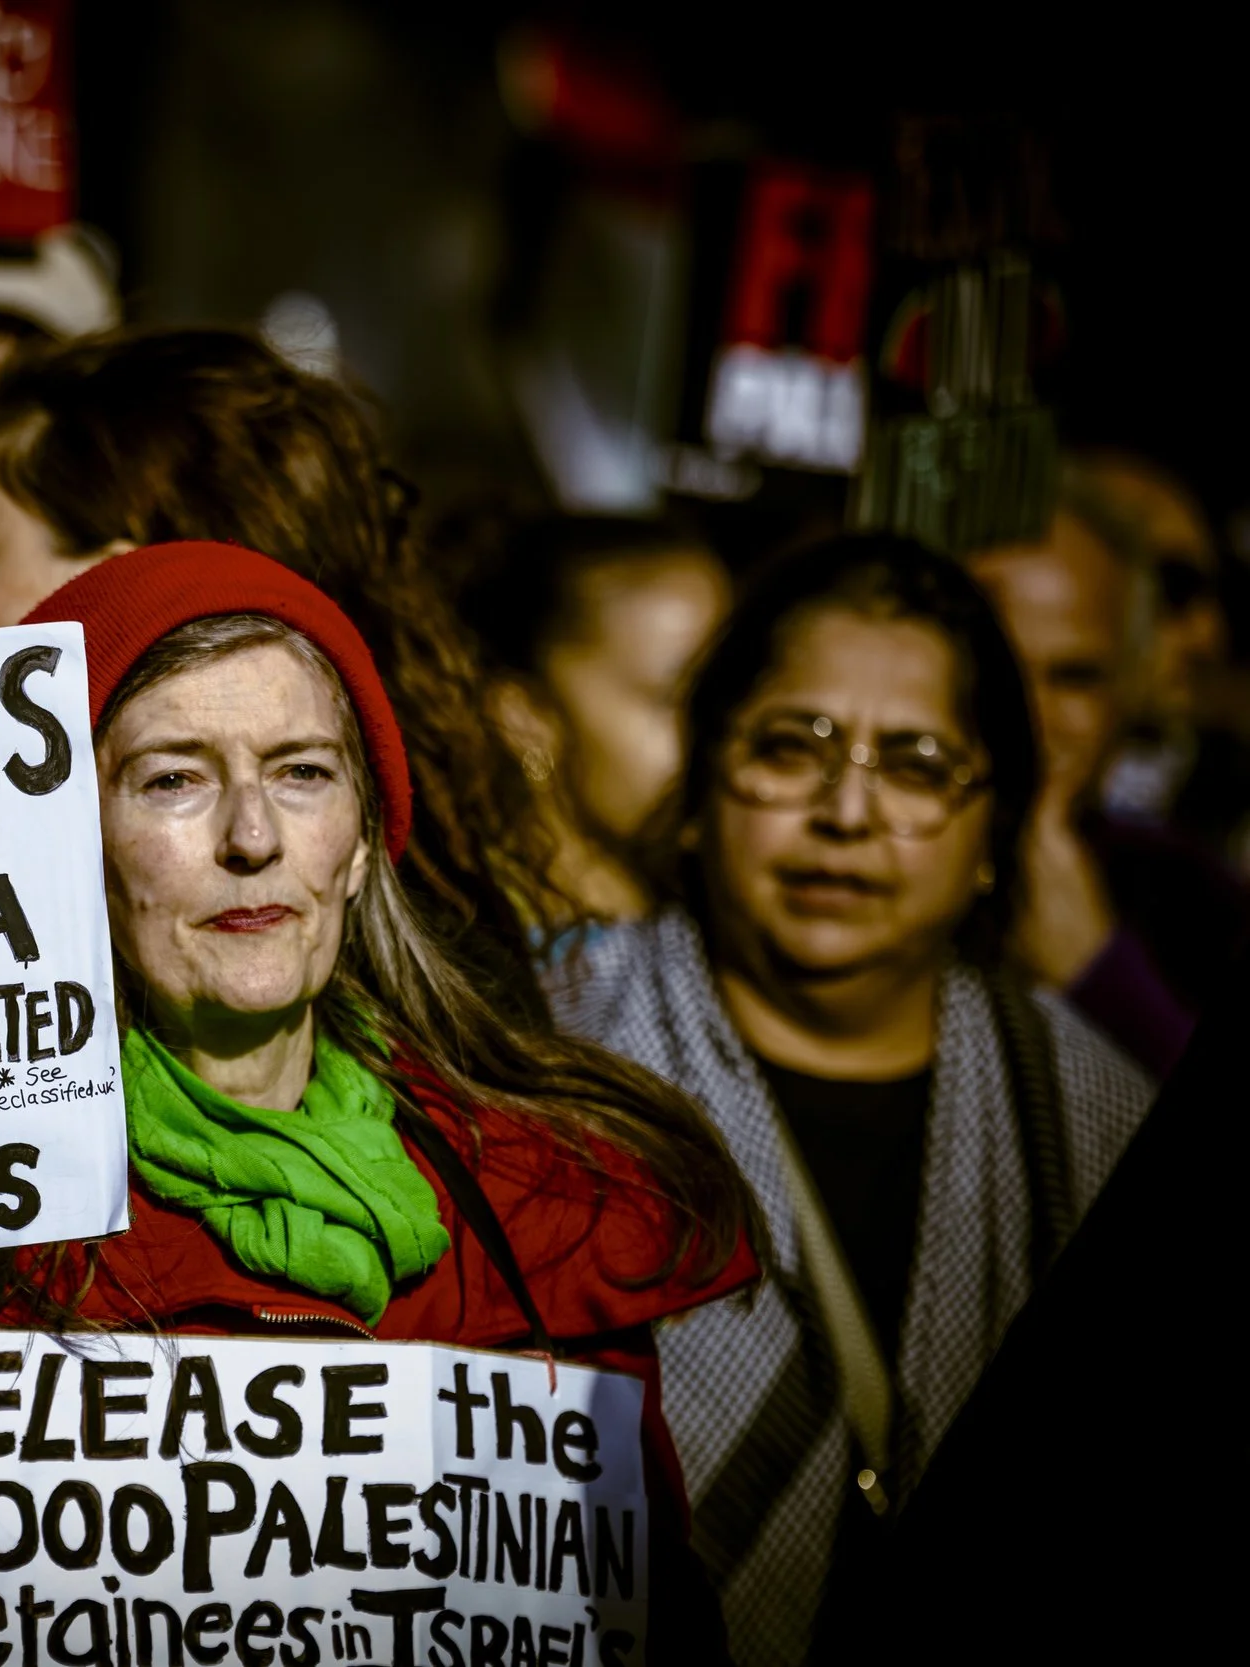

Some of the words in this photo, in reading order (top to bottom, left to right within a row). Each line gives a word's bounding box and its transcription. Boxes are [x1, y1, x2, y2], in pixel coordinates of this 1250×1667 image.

[437, 1362, 603, 1484] the
[181, 1460, 635, 1600] PALESTINIAN
[331, 1610, 374, 1660] in
